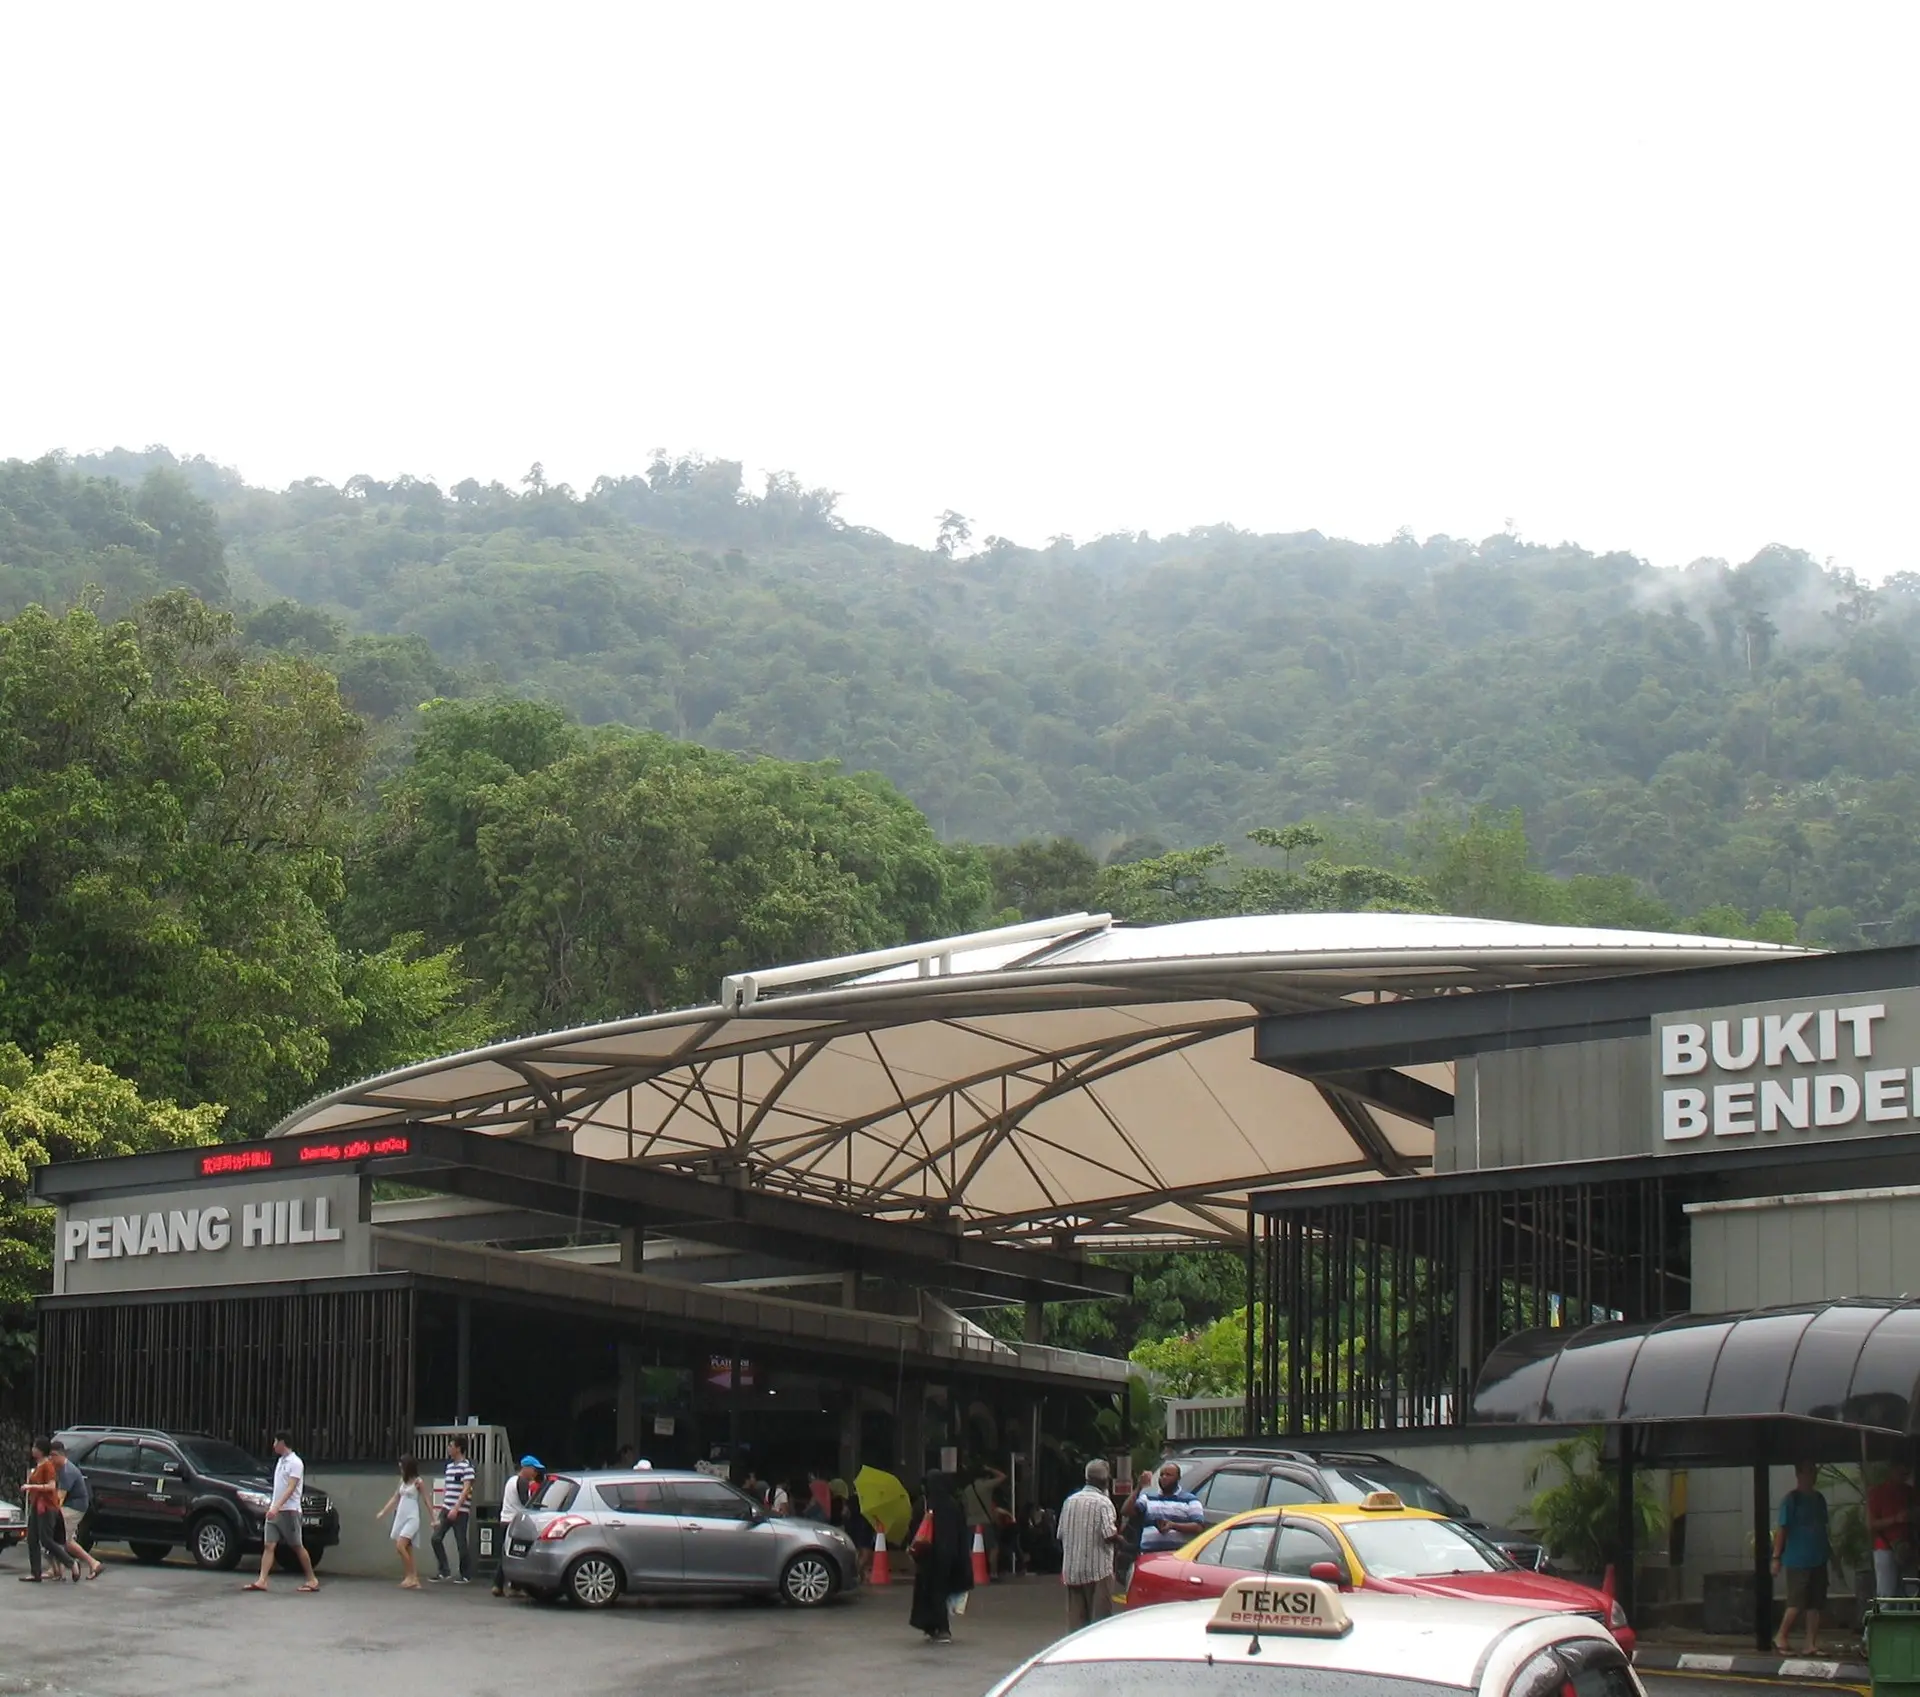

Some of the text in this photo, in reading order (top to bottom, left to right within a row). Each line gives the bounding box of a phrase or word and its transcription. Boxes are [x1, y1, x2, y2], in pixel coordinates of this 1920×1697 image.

[1662, 1004, 1886, 1076] BUKIT
[1662, 1066, 1920, 1141] BENDE
[64, 1197, 342, 1261] PENANG HILL
[1231, 1612, 1323, 1627] BERMETER
[1237, 1589, 1316, 1614] TEKSI
